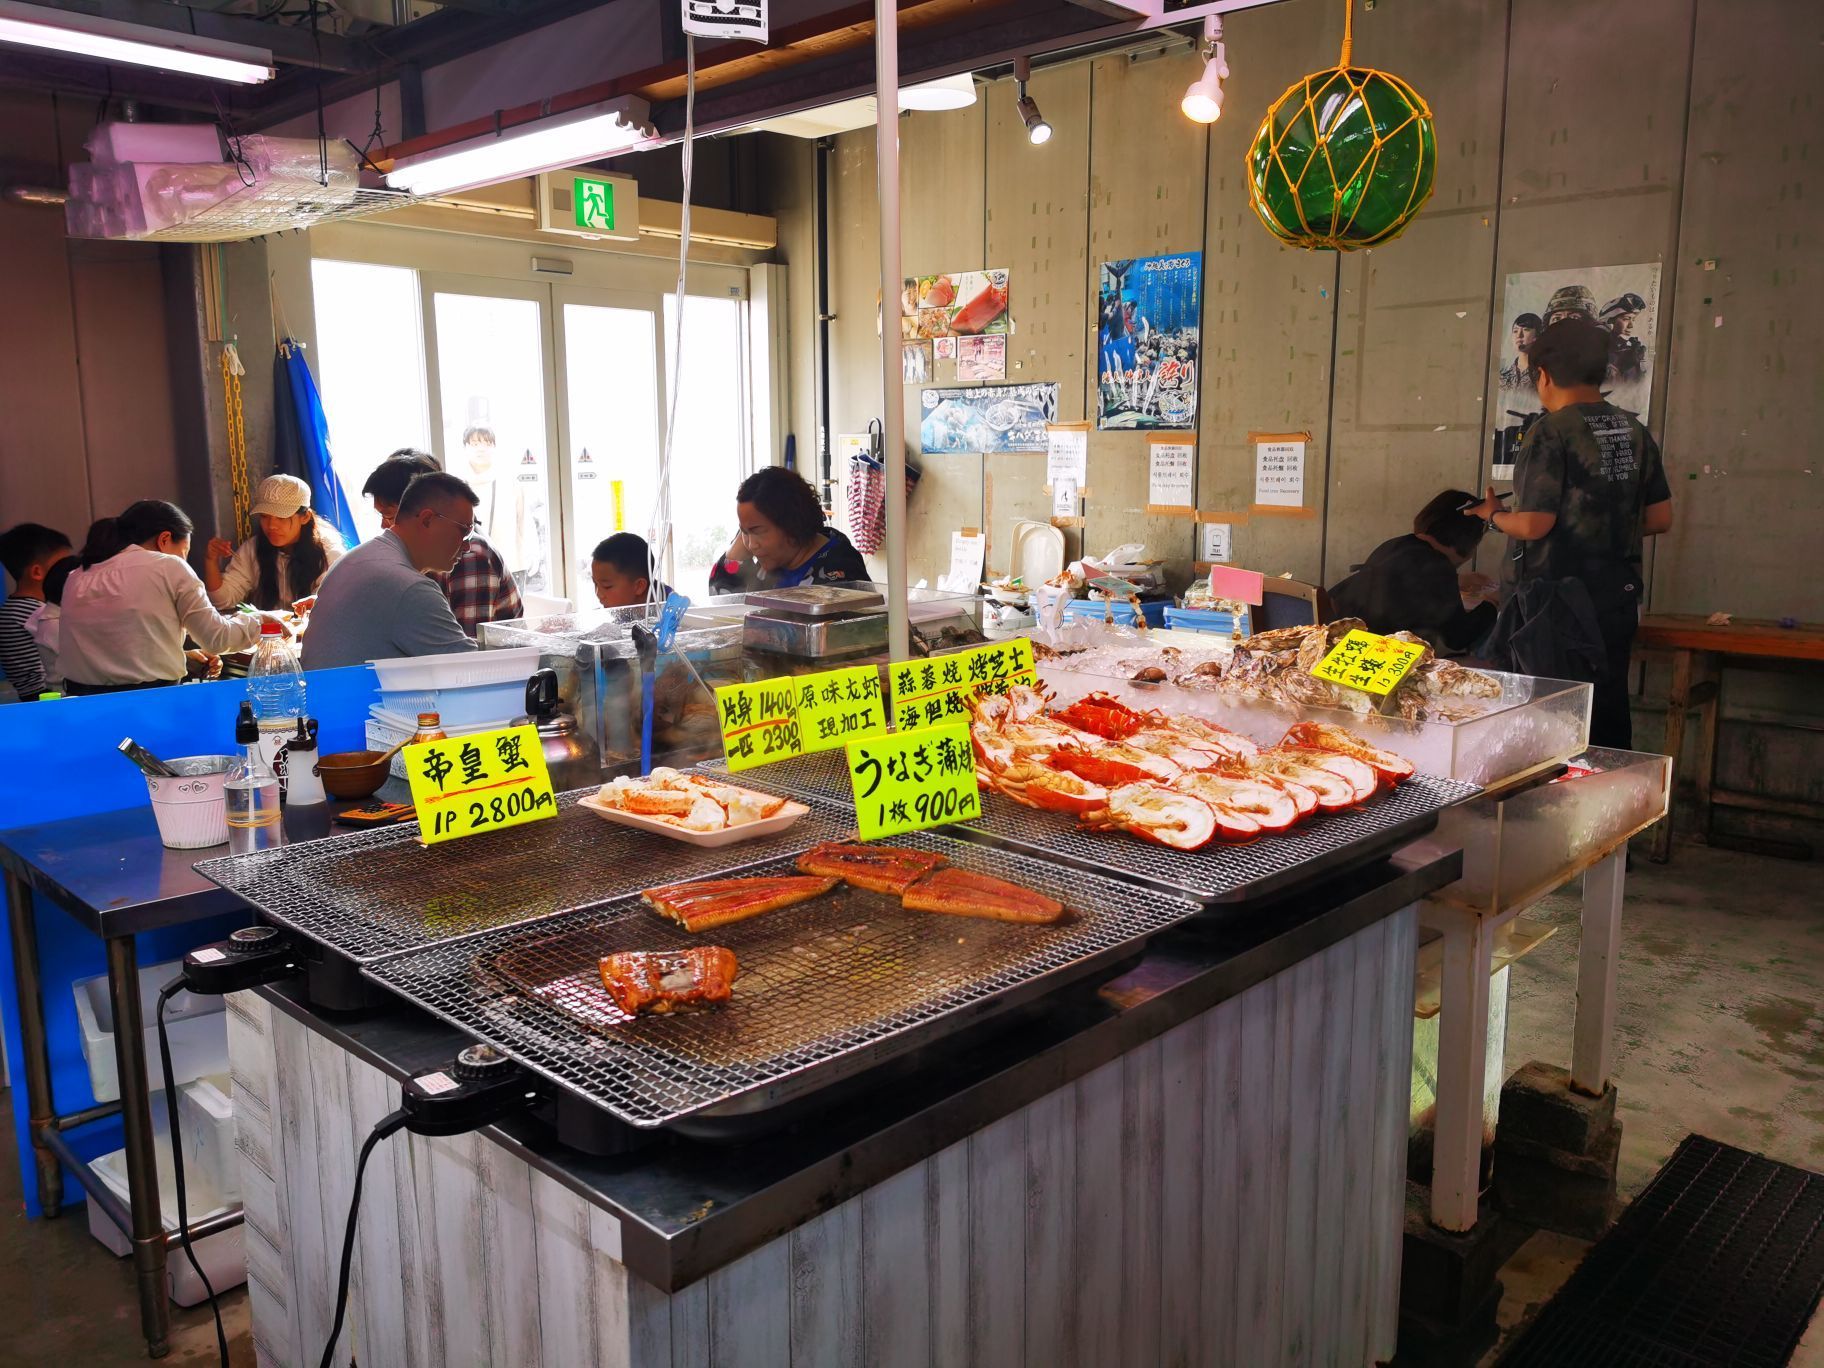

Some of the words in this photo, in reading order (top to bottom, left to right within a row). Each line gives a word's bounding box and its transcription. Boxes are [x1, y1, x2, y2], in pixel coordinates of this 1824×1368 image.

[759, 688, 798, 720] 1400円
[727, 732, 755, 759] 一匹
[762, 721, 802, 755] 2300円
[422, 734, 530, 792] 帝皇蟹
[854, 736, 974, 799] うなぎ蒲焼
[468, 786, 554, 829] 2800円
[879, 798, 912, 827] 1枚
[914, 787, 976, 823] 900円
